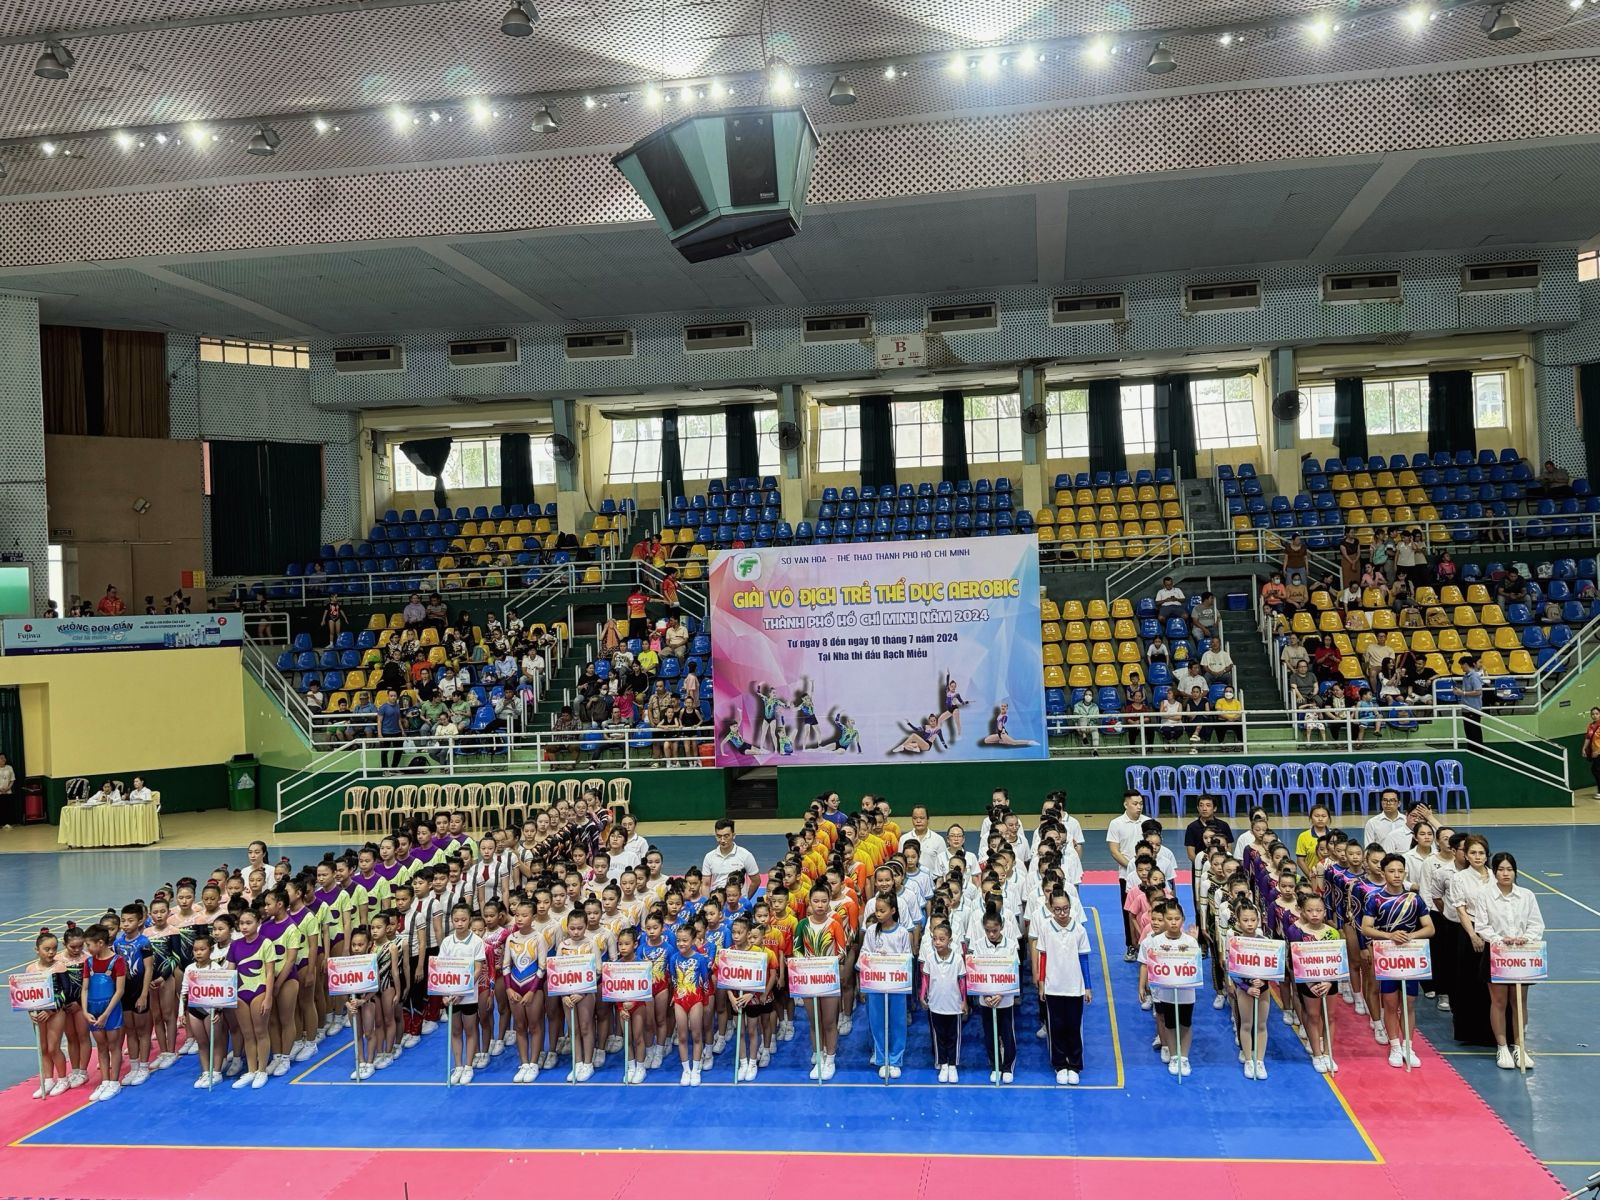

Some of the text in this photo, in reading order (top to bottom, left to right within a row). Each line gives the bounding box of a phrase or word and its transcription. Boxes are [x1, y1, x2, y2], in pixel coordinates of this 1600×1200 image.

[895, 342, 906, 352] B
[854, 553, 872, 561] THAO
[950, 548, 970, 556] MINH
[769, 586, 794, 609] VÔ
[799, 586, 838, 611] ĐỊCH
[842, 580, 872, 606] TRẺ
[876, 577, 907, 605] THỂ
[909, 582, 944, 605] DỤC
[948, 578, 1020, 601] AEROBIC
[883, 612, 918, 626] MINH
[920, 609, 952, 624] NĂM
[954, 608, 990, 622] 2024
[18, 632, 40, 640] Fujiwa
[822, 638, 828, 646] 8
[871, 636, 880, 644] 10
[909, 634, 914, 643] 7
[937, 633, 958, 642] 2024
[852, 651, 862, 660] thi
[1174, 962, 1197, 976] VẤP
[1379, 954, 1428, 972] QUẬN 5
[1496, 958, 1526, 970] TRỌNG
[330, 970, 375, 986] QUẬN 4
[430, 971, 470, 988] QUẬN 7
[550, 970, 594, 986] QUẬN 8
[722, 966, 752, 982] QUẬN
[16, 984, 43, 1002] QUẬN
[192, 984, 234, 1000] QUẬN 3
[606, 977, 648, 994] QUẬN 10
